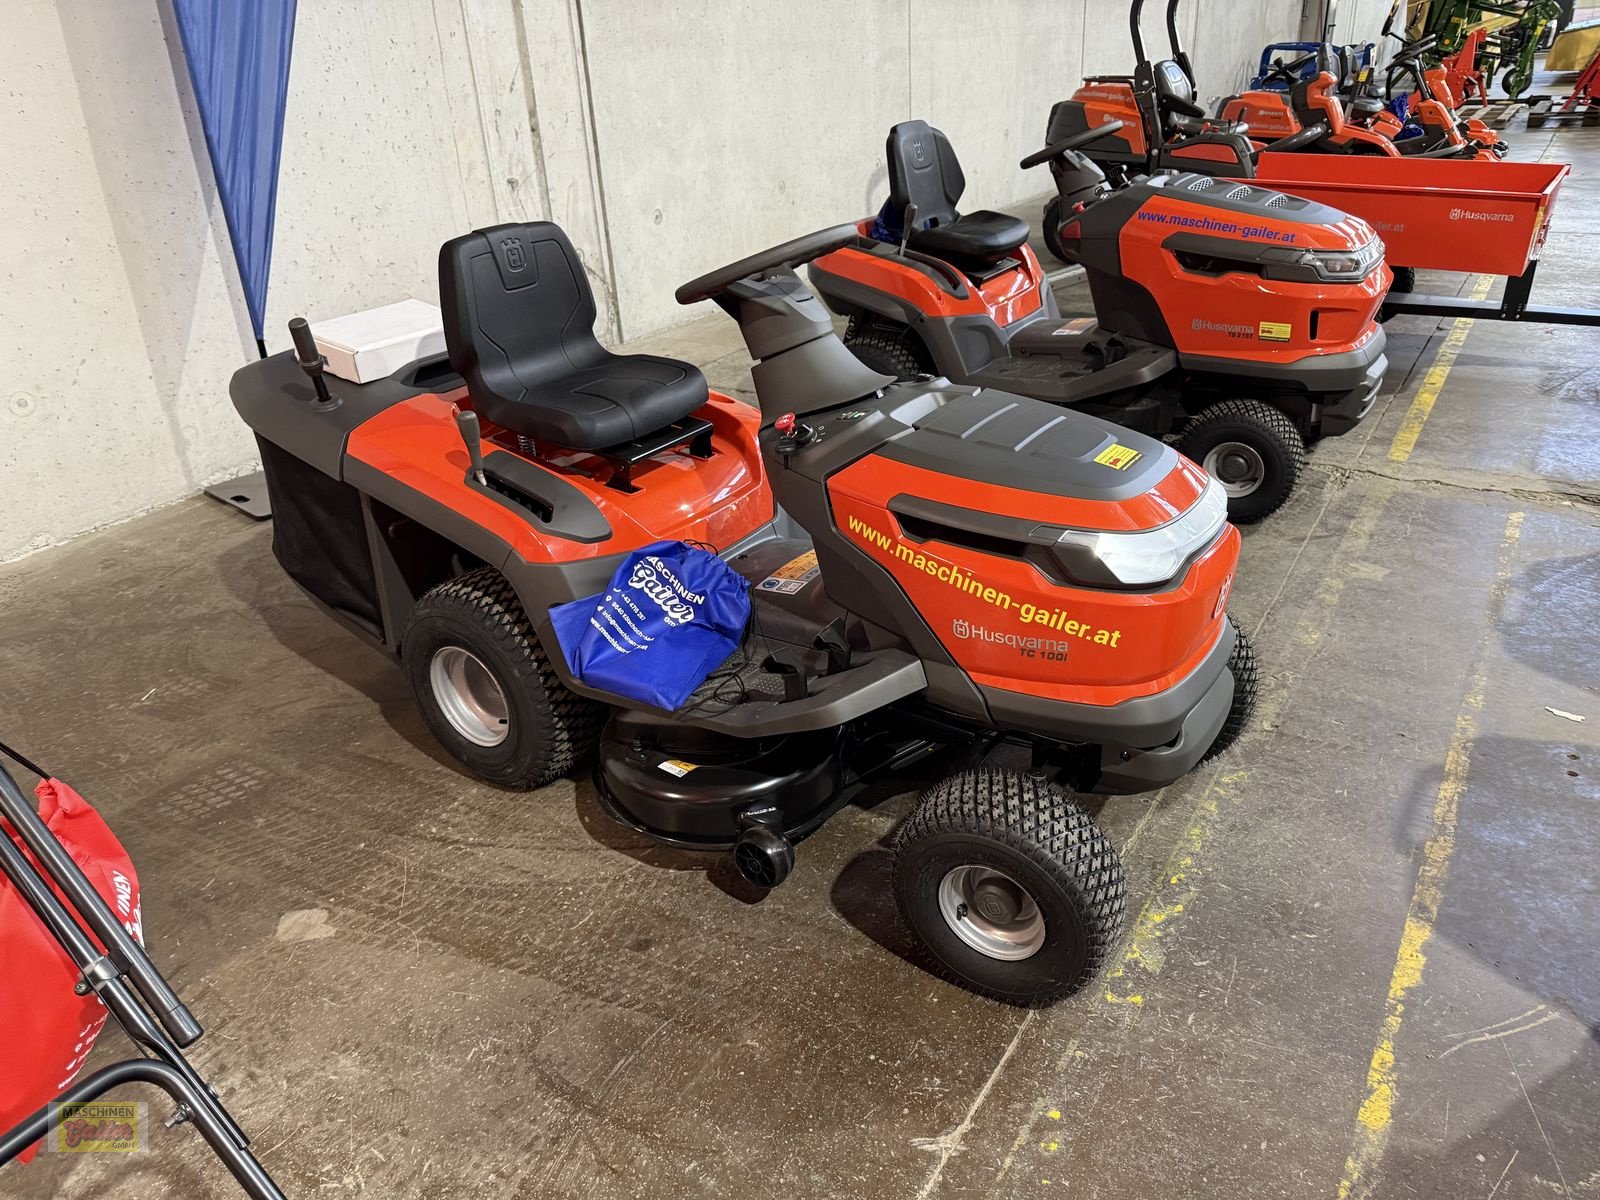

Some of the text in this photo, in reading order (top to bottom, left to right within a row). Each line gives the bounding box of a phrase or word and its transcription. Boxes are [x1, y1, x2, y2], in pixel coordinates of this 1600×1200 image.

[1138, 210, 1297, 243] www.maschinen-gailer.at
[1460, 209, 1515, 222] Husqvarna
[1202, 320, 1254, 334] Husqvarna
[628, 561, 695, 624] Gailer
[848, 515, 1122, 649] www.maschinen-gailer.at
[971, 624, 1069, 653] Husqvarna
[1019, 647, 1036, 658] TC
